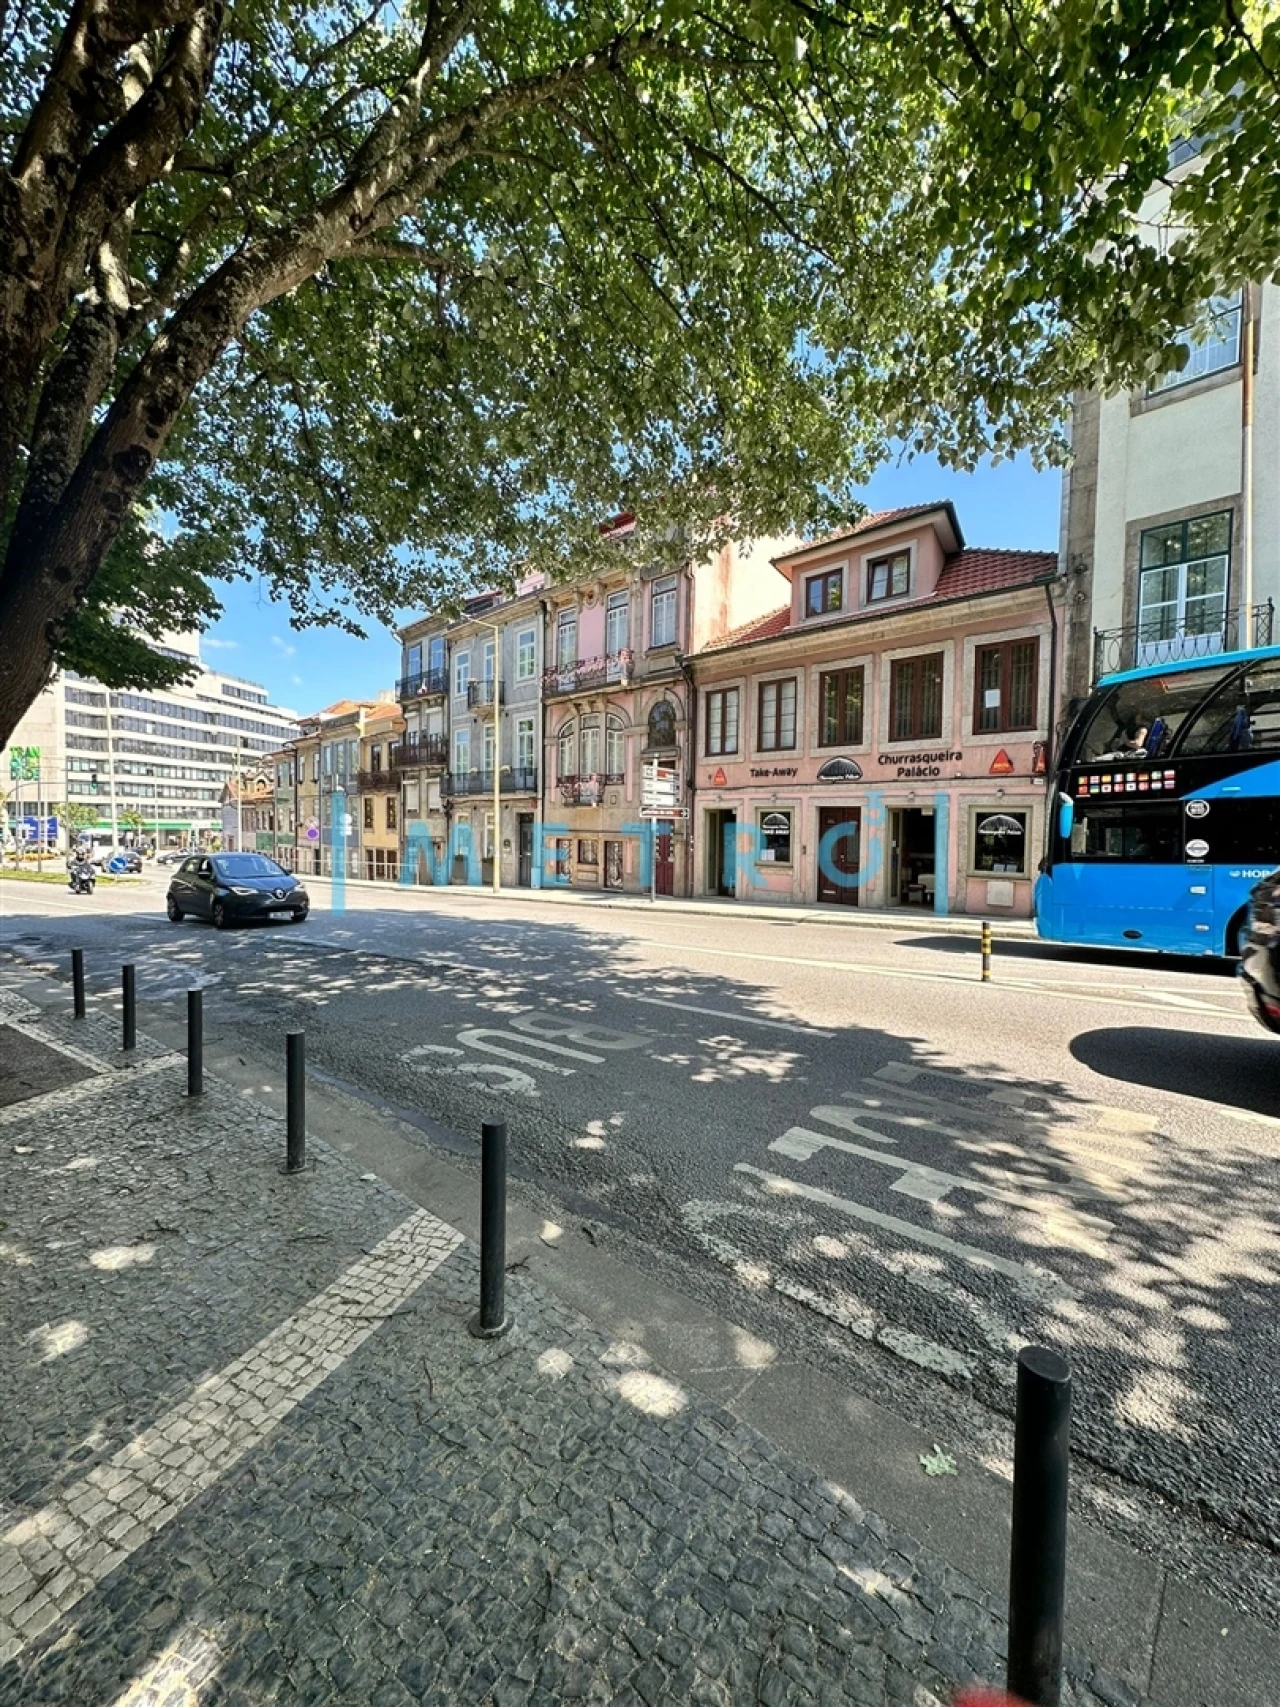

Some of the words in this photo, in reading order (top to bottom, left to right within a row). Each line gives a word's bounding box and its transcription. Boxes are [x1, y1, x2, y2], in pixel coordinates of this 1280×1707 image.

[878, 750, 963, 766] Churrasqueira
[749, 767, 798, 778] Take-Away
[897, 766, 940, 778] Palácio
[1242, 869, 1272, 878] HOP
[400, 1011, 656, 1098] BUS
